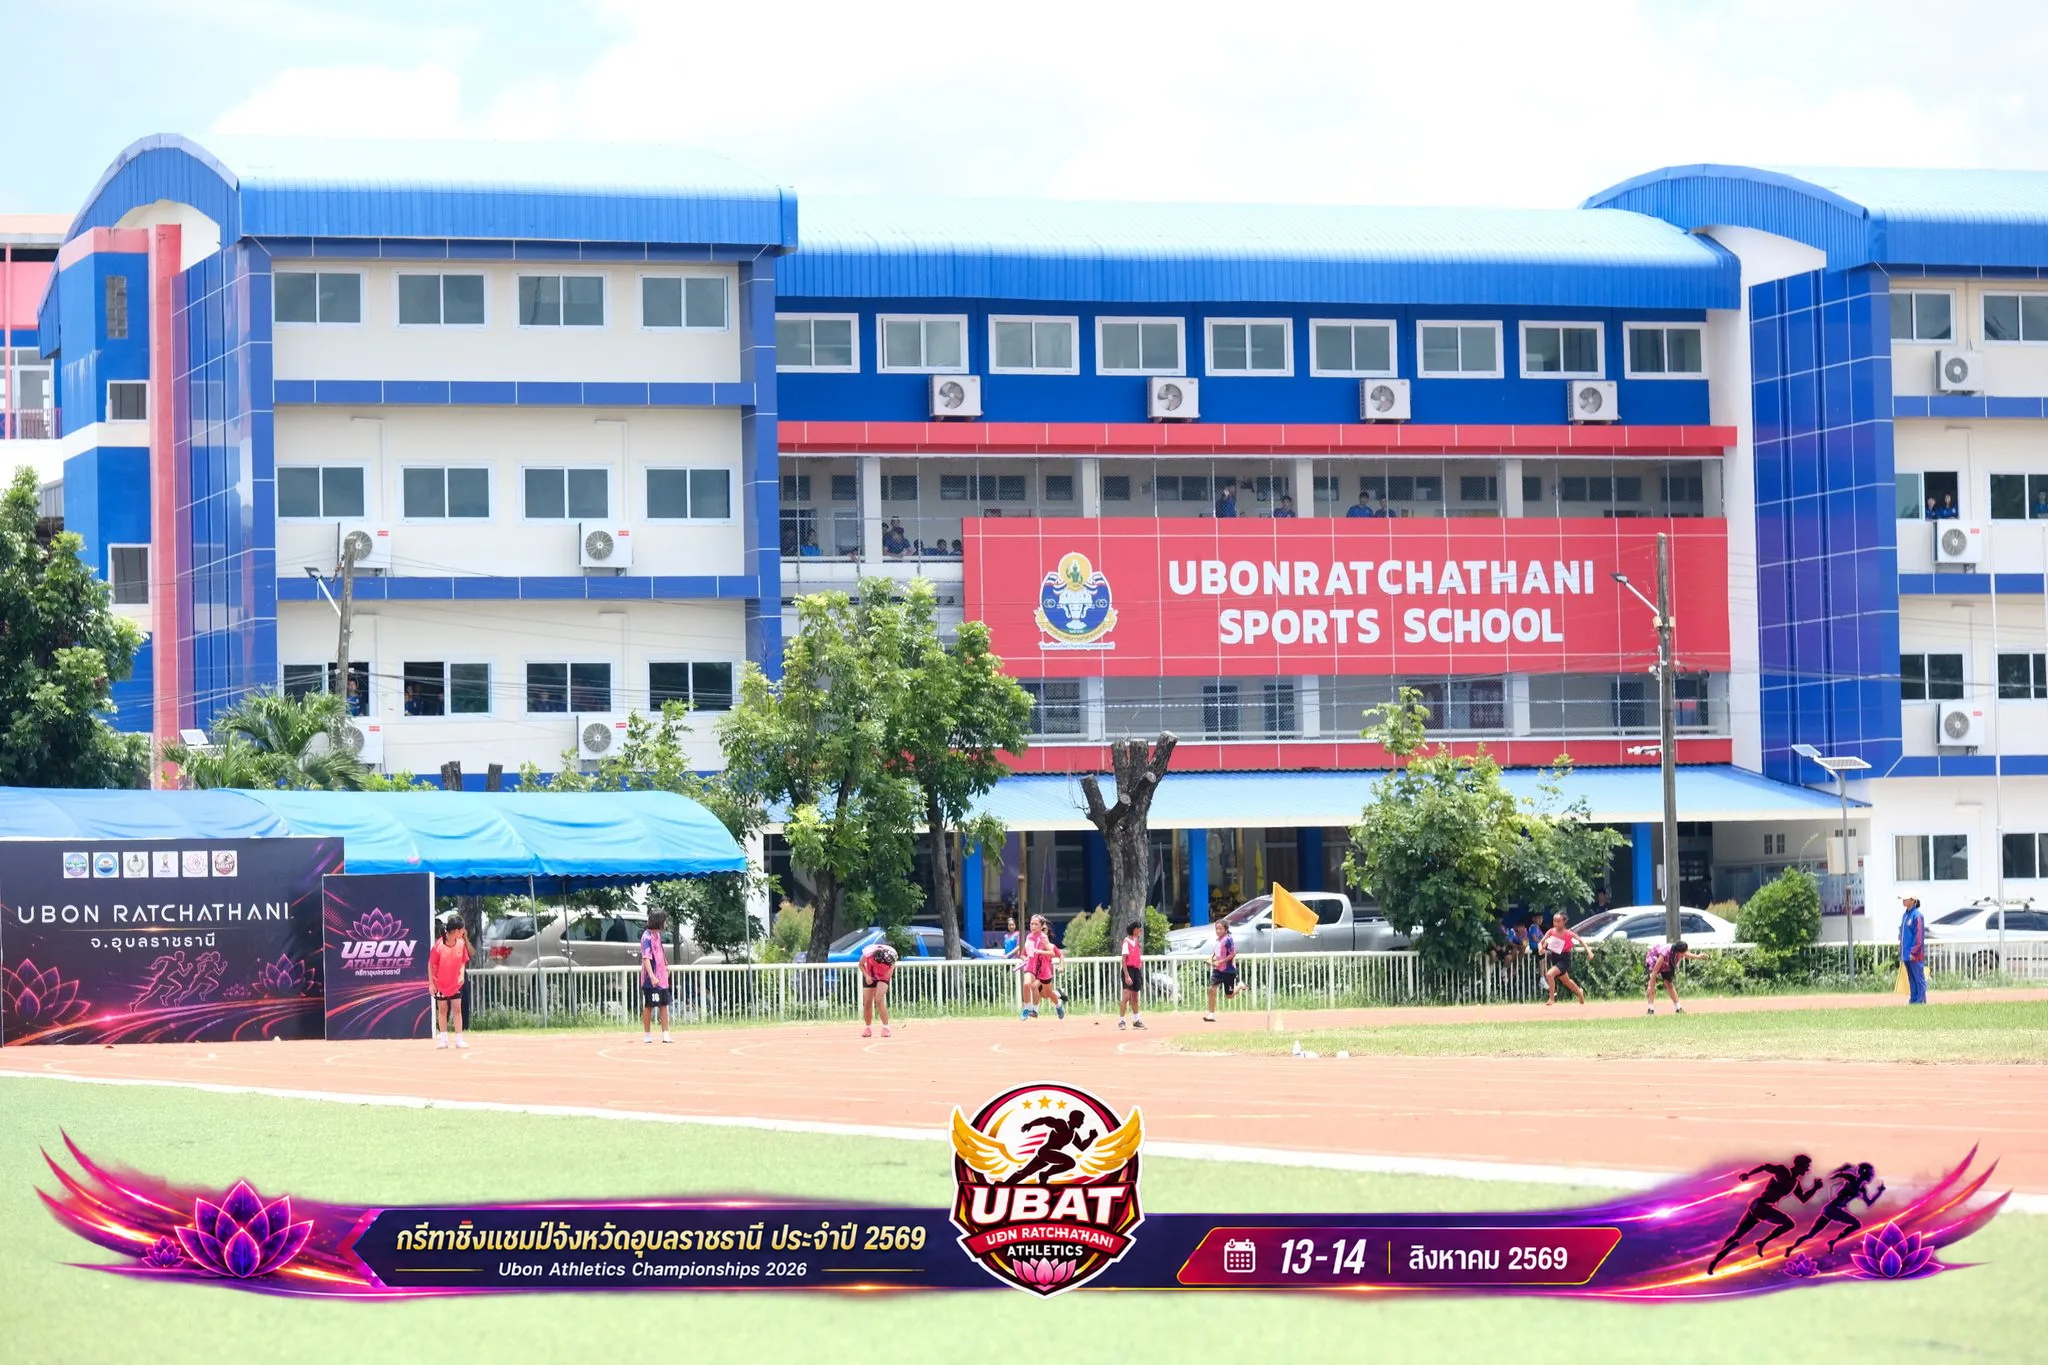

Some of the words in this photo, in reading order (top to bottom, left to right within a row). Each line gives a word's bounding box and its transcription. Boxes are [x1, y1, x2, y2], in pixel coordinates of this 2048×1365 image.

[1169, 559, 1594, 596] UBONRATCHATHANI
[1219, 608, 1380, 645] SPORTS
[1403, 607, 1564, 643] SCHOOL
[17, 904, 99, 924] UBON
[113, 902, 289, 923] RATCHATHANI
[90, 931, 215, 953] จ.อุบลราชธานี
[341, 939, 418, 959] UBON
[343, 957, 414, 969] ATHLETICS
